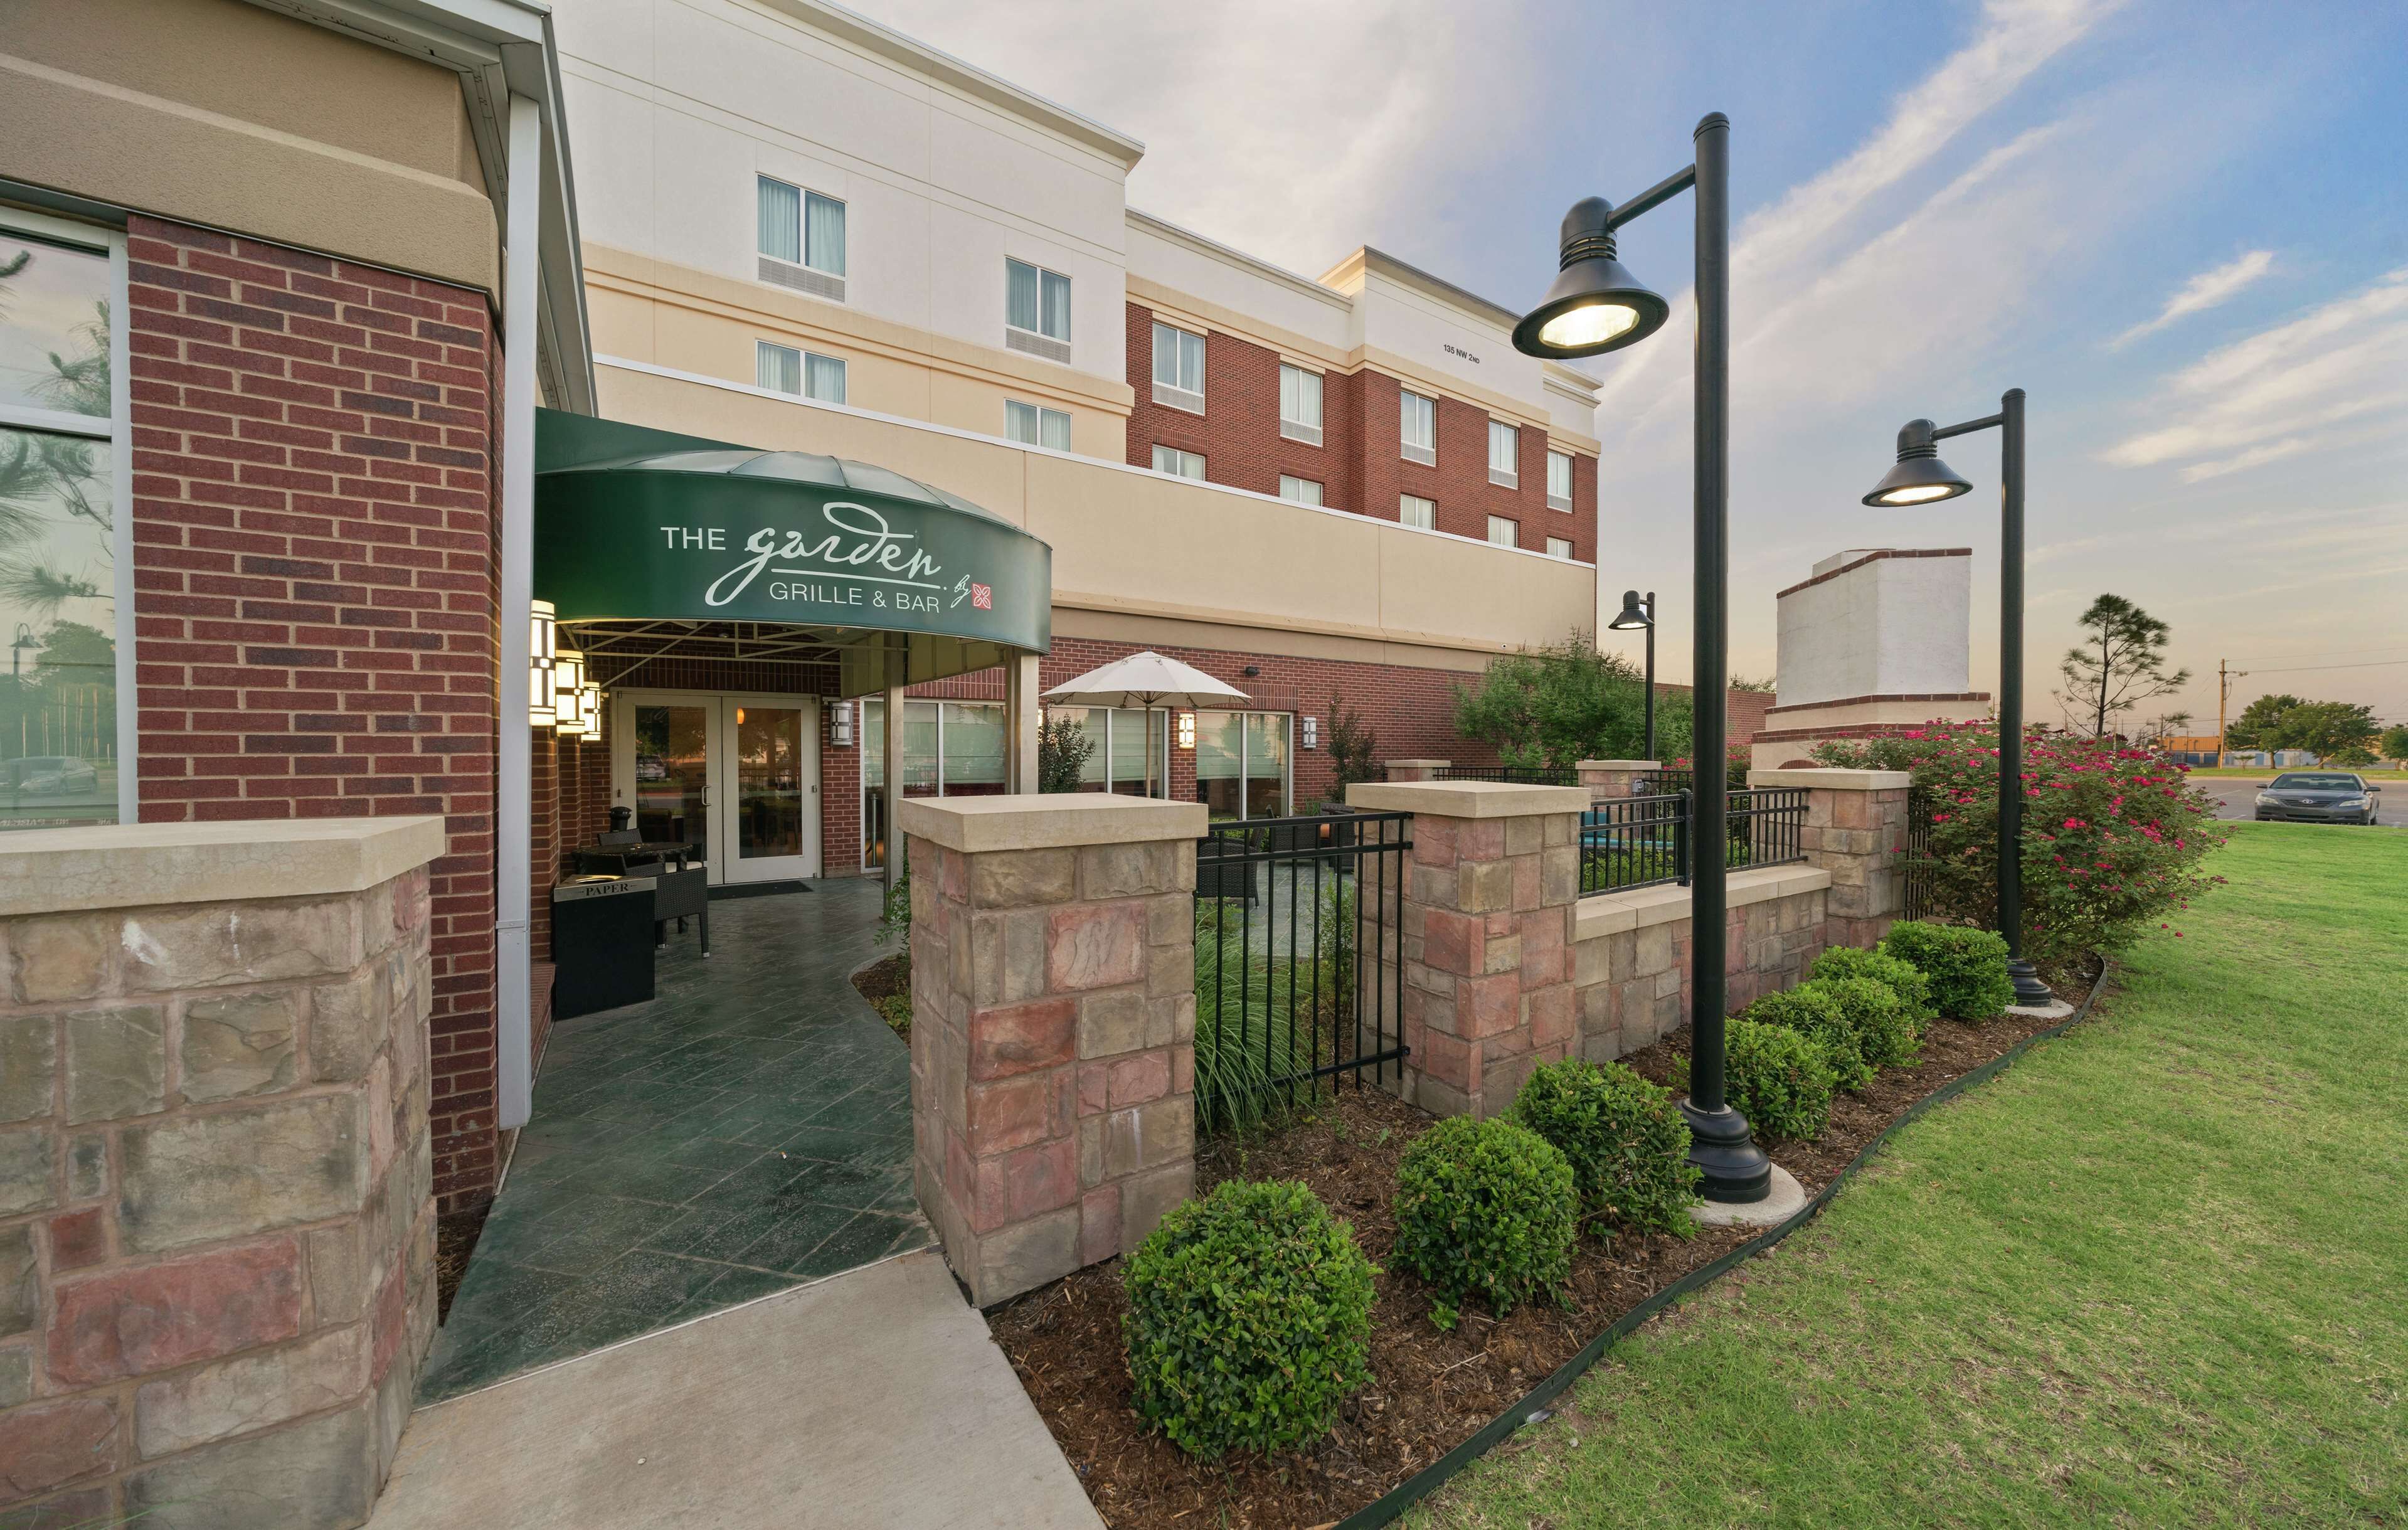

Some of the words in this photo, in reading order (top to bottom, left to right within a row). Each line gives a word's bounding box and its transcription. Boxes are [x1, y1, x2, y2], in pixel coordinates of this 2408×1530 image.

[1444, 344, 1455, 354] 135
[1456, 349, 1467, 359] NW
[660, 527, 726, 550] THE
[704, 502, 942, 607] garden
[770, 582, 863, 605] GRILLE
[873, 590, 888, 608] &
[896, 592, 940, 614] BAR
[950, 573, 972, 608] by
[586, 883, 629, 896] PAPER
